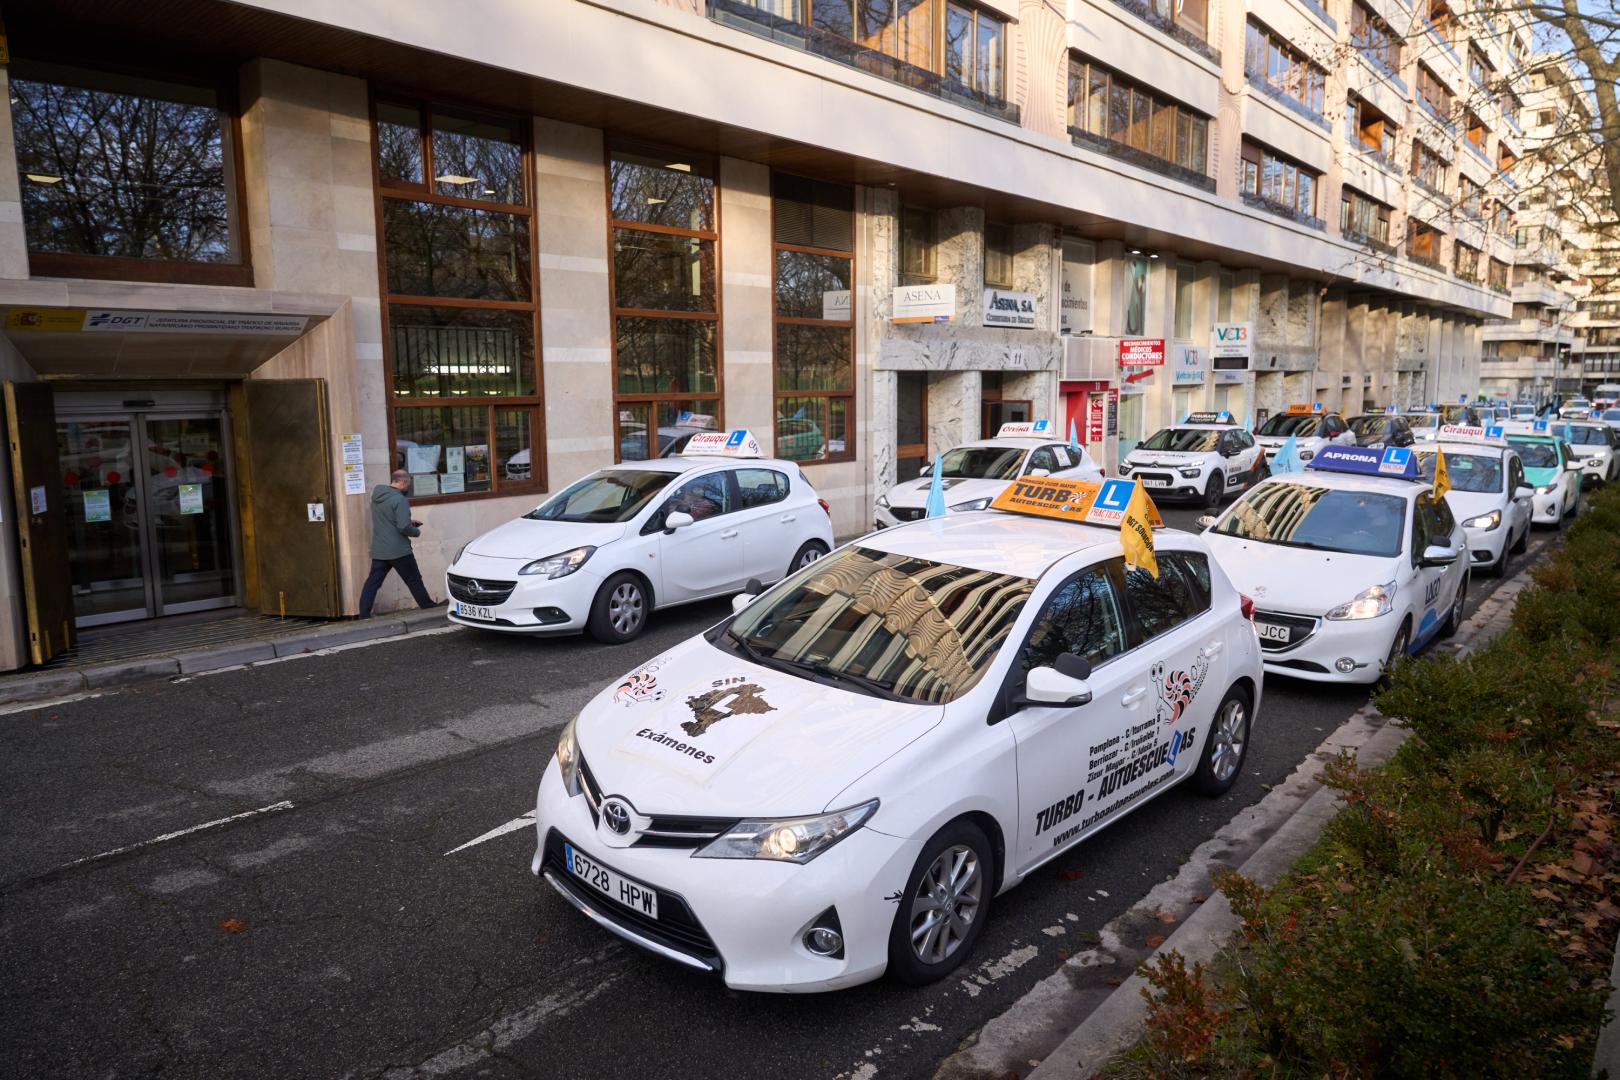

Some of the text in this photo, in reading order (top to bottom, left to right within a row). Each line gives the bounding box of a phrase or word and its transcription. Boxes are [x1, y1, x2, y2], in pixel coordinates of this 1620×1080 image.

[904, 289, 941, 302] ASENA
[1121, 352, 1162, 360] CONDUCTORES
[1130, 345, 1153, 353] MÉDICOS
[1014, 353, 1022, 365] 11
[1443, 425, 1497, 437] Cirauqui L
[692, 432, 739, 445] Cirauqui L
[1323, 449, 1402, 463] APRONA L
[1103, 484, 1120, 507] L
[1425, 577, 1441, 605] LAGO
[478, 607, 494, 620] KZL
[1260, 625, 1286, 640] JCC
[711, 676, 746, 688] SIN
[636, 728, 716, 764] Exámenes
[1089, 735, 1120, 756] Pamplona
[1089, 749, 1118, 770] Berriozar
[1087, 768, 1104, 783] Zizur
[1105, 757, 1125, 773] Mayor
[1035, 788, 1085, 836] TURBO
[574, 854, 653, 914] 6728 HPW
